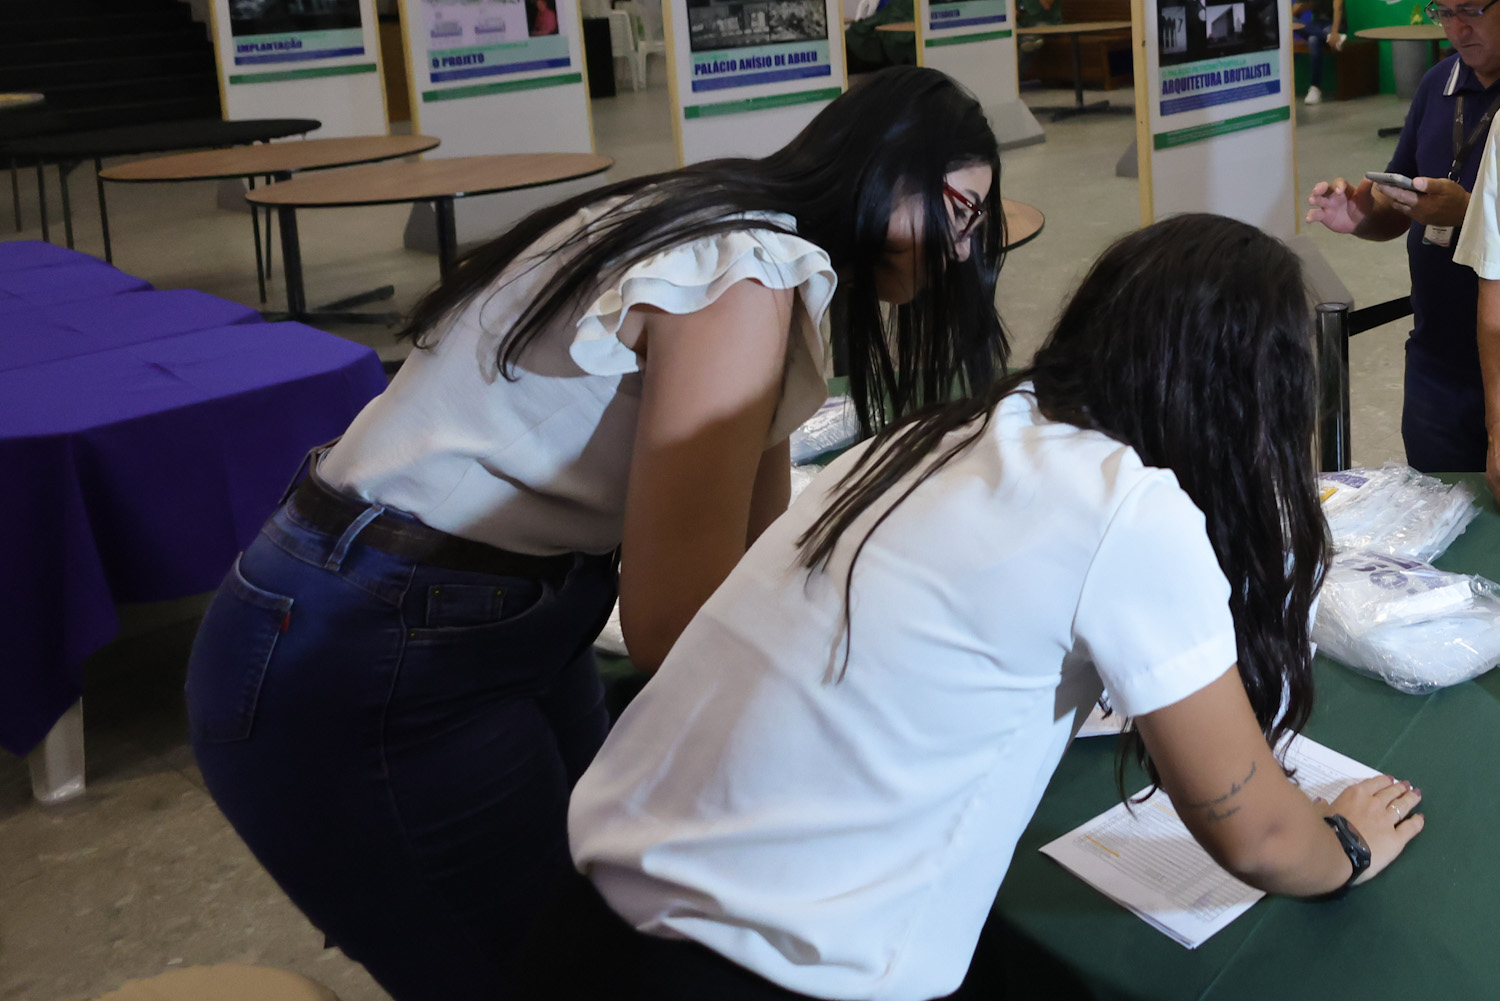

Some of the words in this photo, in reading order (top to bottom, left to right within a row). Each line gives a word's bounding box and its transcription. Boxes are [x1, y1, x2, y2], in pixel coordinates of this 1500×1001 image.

[237, 38, 302, 53] IMPLANTAÇÃO
[442, 53, 485, 67] PROJETO
[694, 60, 737, 76] PALÁCIO
[740, 54, 772, 70] ANÍSIO
[774, 53, 786, 66] DE
[788, 51, 818, 64] ABREU
[1162, 71, 1222, 95] ARQUITETURA
[1224, 63, 1271, 84] BRUTALISTA
